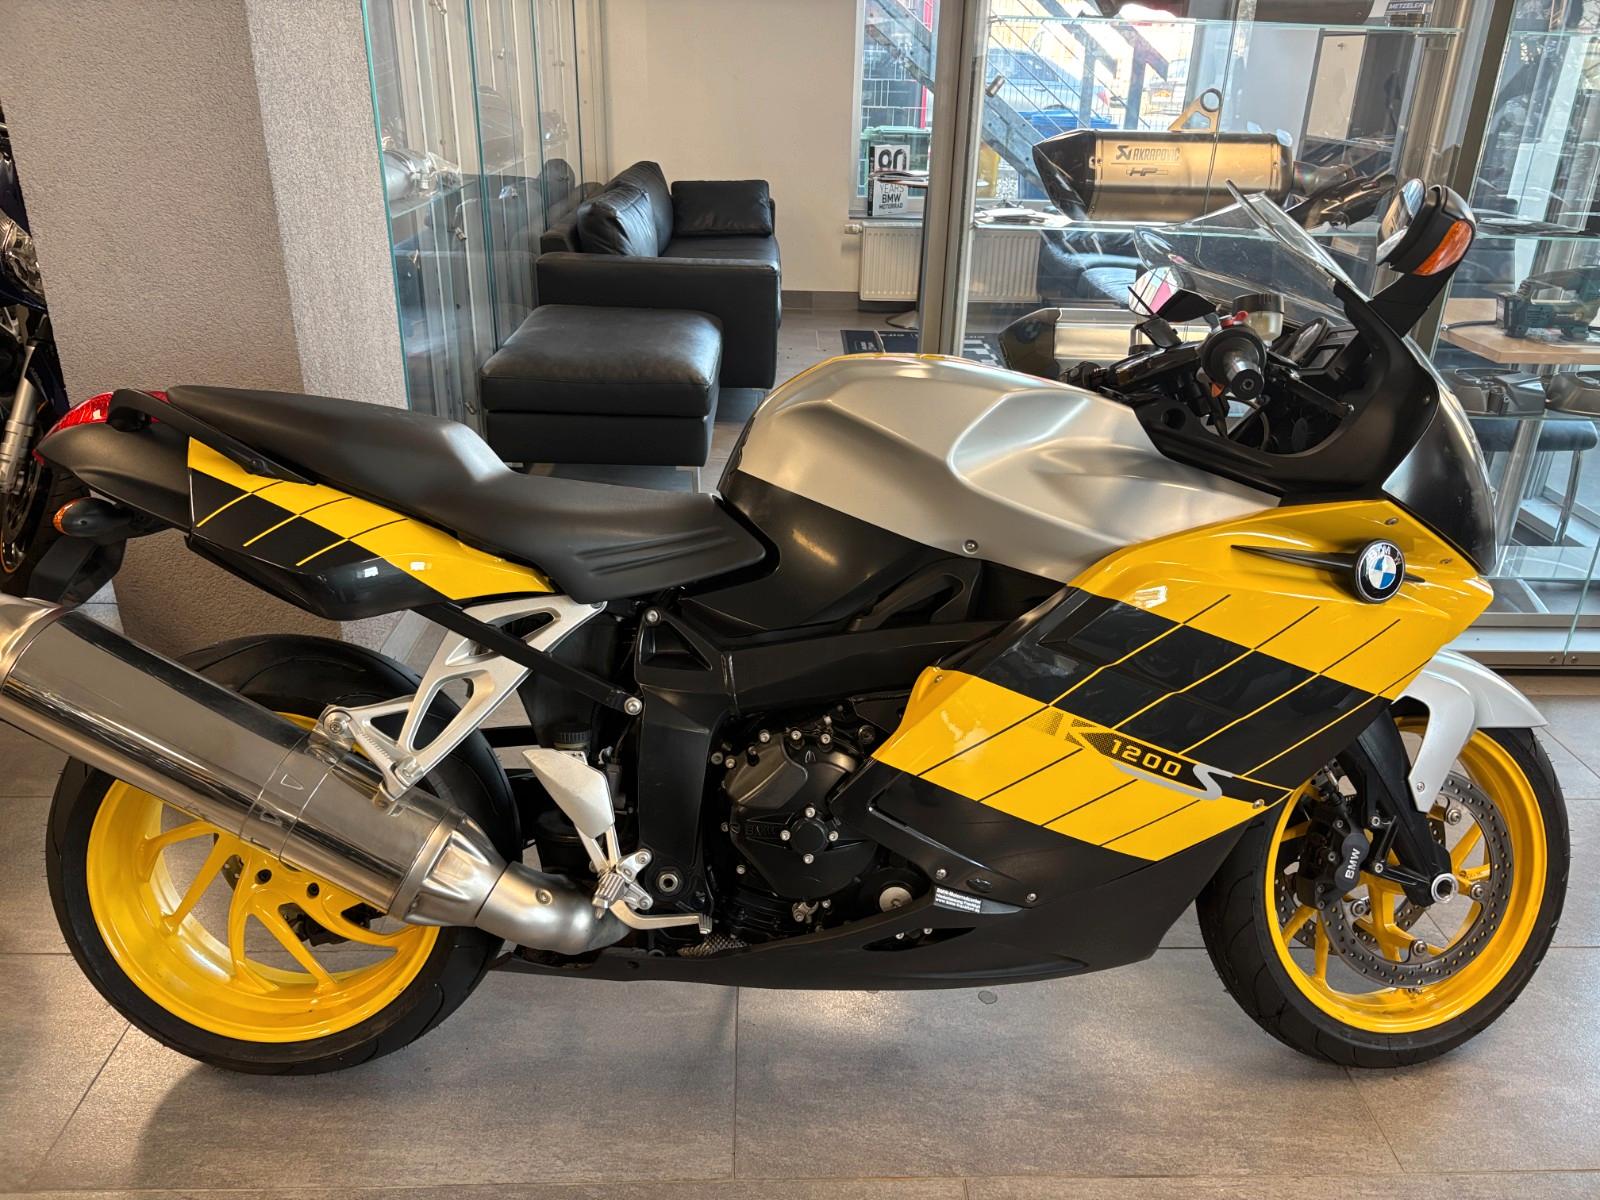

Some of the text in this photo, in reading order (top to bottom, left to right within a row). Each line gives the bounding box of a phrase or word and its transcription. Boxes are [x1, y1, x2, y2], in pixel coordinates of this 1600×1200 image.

[880, 184, 904, 193] YEARS
[882, 194, 901, 203] BMW
[1111, 738, 1182, 777] 1200
[1344, 847, 1361, 880] BMW
